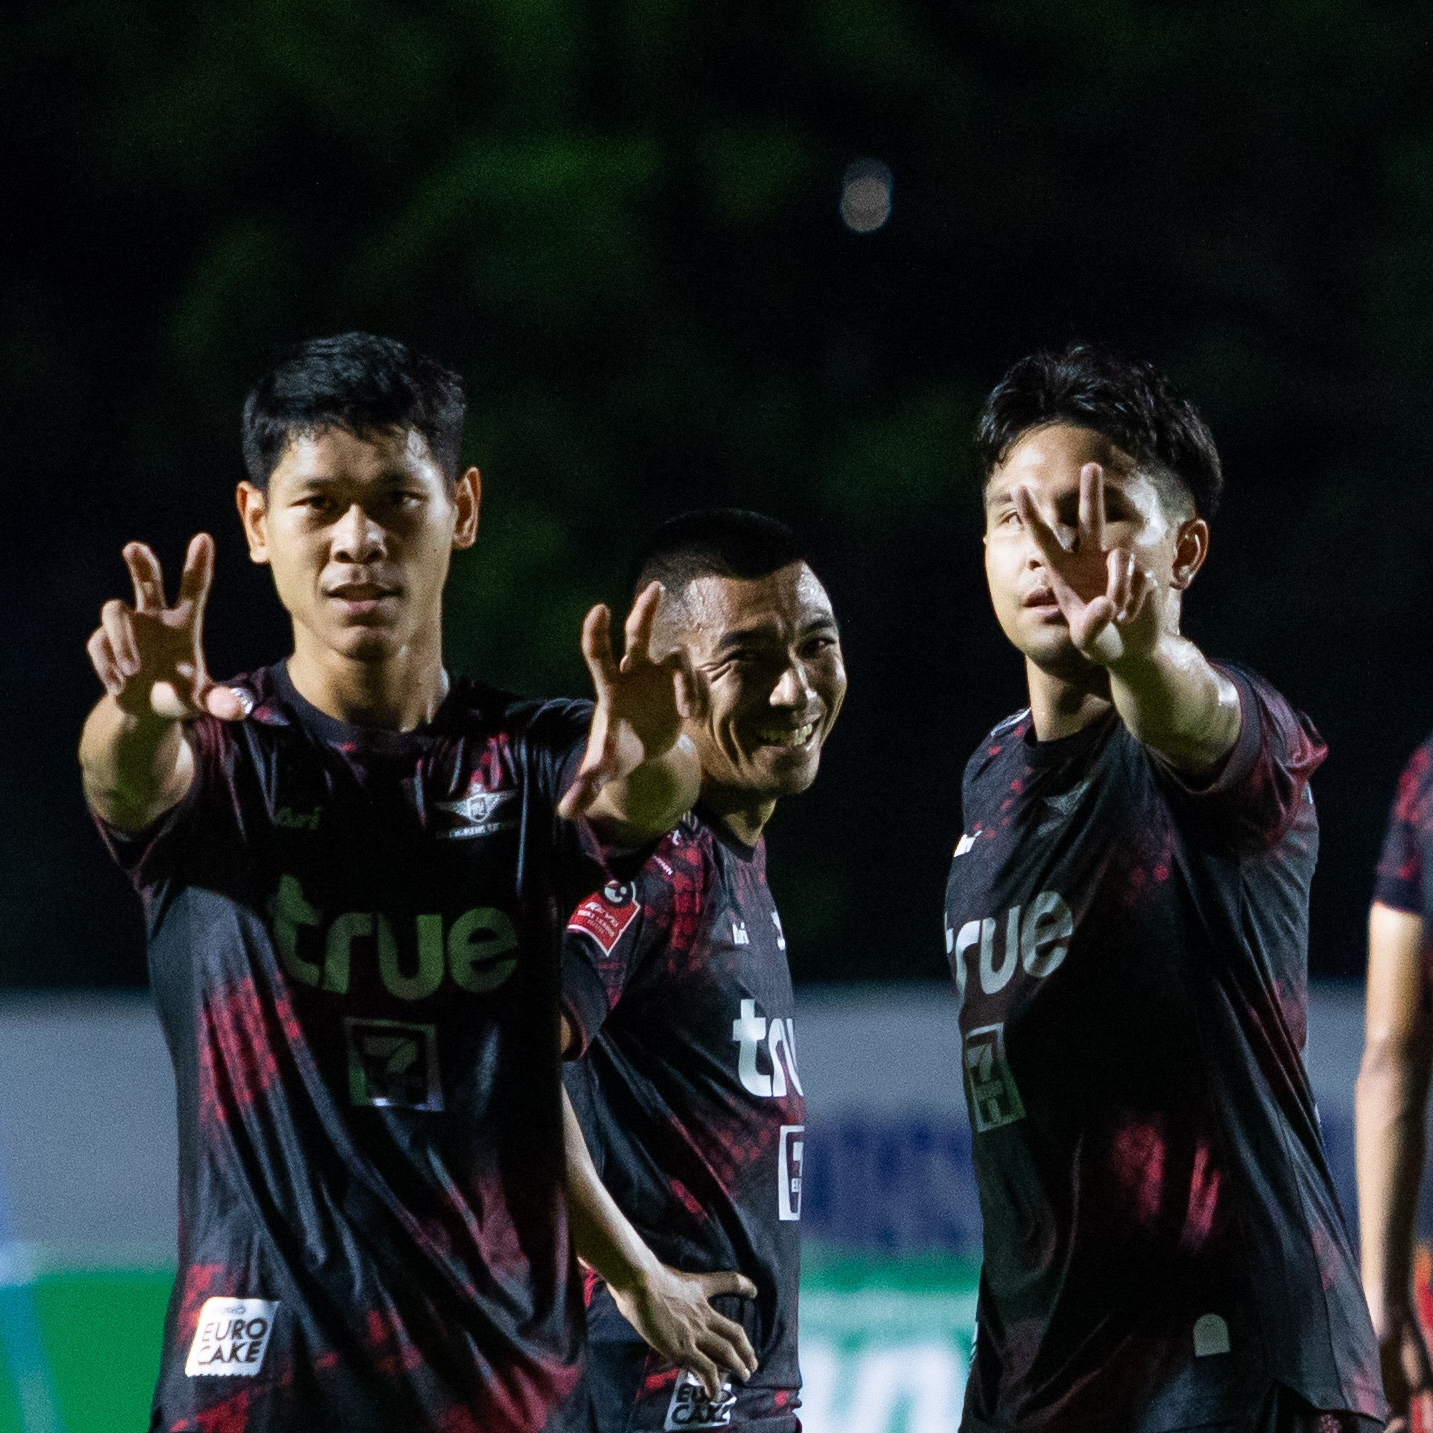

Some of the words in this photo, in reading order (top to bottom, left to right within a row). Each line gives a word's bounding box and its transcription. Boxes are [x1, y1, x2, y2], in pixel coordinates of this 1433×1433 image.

[273, 873, 519, 1001] true
[945, 890, 1075, 997] rue
[197, 1340, 262, 1366] CAKE
[201, 1318, 268, 1342] EURO
